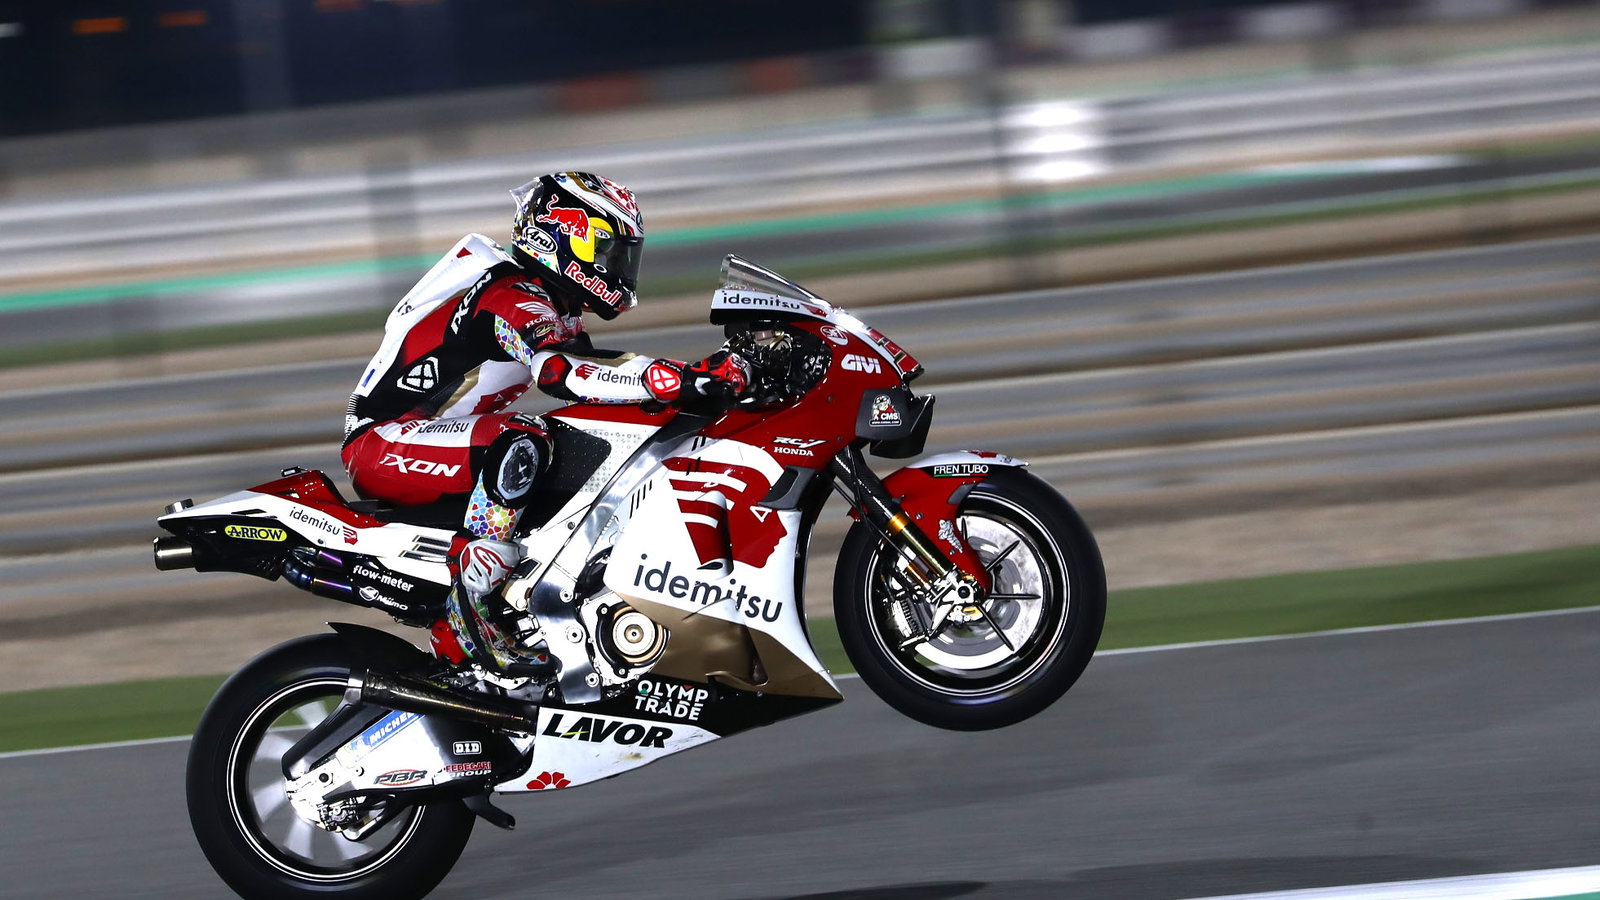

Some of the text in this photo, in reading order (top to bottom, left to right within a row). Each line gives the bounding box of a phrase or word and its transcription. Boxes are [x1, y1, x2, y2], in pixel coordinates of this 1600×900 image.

[527, 230, 552, 248] Arai
[722, 290, 800, 310] idemitsu
[841, 354, 882, 374] GIVI
[597, 369, 642, 387] idemit
[881, 413, 898, 421] CMS
[774, 447, 814, 456] HONDA
[934, 464, 989, 475] FREN TUBO
[289, 506, 341, 536] idemitsu
[227, 525, 283, 541] ARROW
[352, 565, 415, 592] flow-meter
[633, 553, 783, 623] idemitsu
[637, 679, 708, 704] OLYMP
[634, 695, 703, 721] TRADE
[542, 713, 673, 749] LAVOR
[446, 762, 492, 772] FEDEGARI
